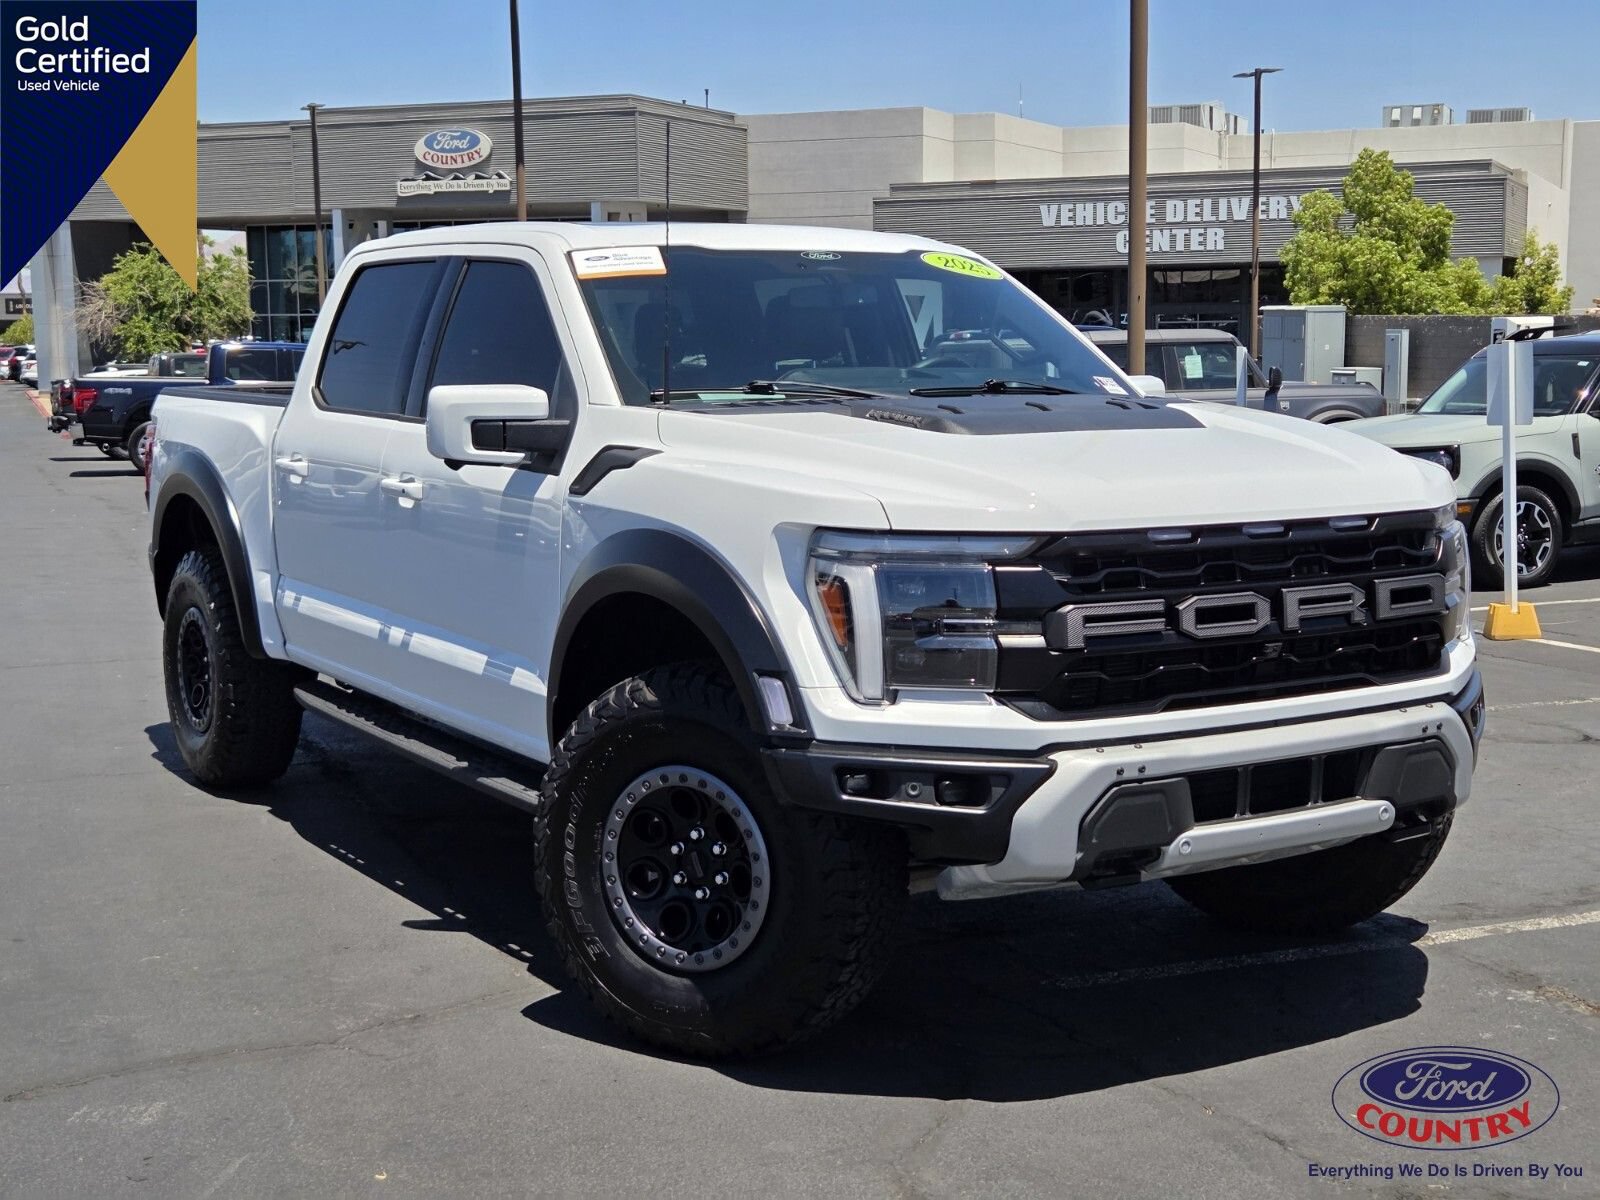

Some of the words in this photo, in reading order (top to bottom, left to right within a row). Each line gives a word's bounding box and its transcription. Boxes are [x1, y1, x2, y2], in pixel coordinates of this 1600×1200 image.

[433, 131, 470, 149] Ford
[423, 148, 483, 165] COUNTRY
[399, 183, 432, 191] Everything
[463, 181, 485, 189] Driven
[486, 180, 495, 189] By
[496, 180, 508, 188] You
[1039, 201, 1156, 227] VEHICE
[808, 251, 833, 260] Ford
[937, 256, 992, 276] 2025
[1045, 573, 1445, 649] FORD
